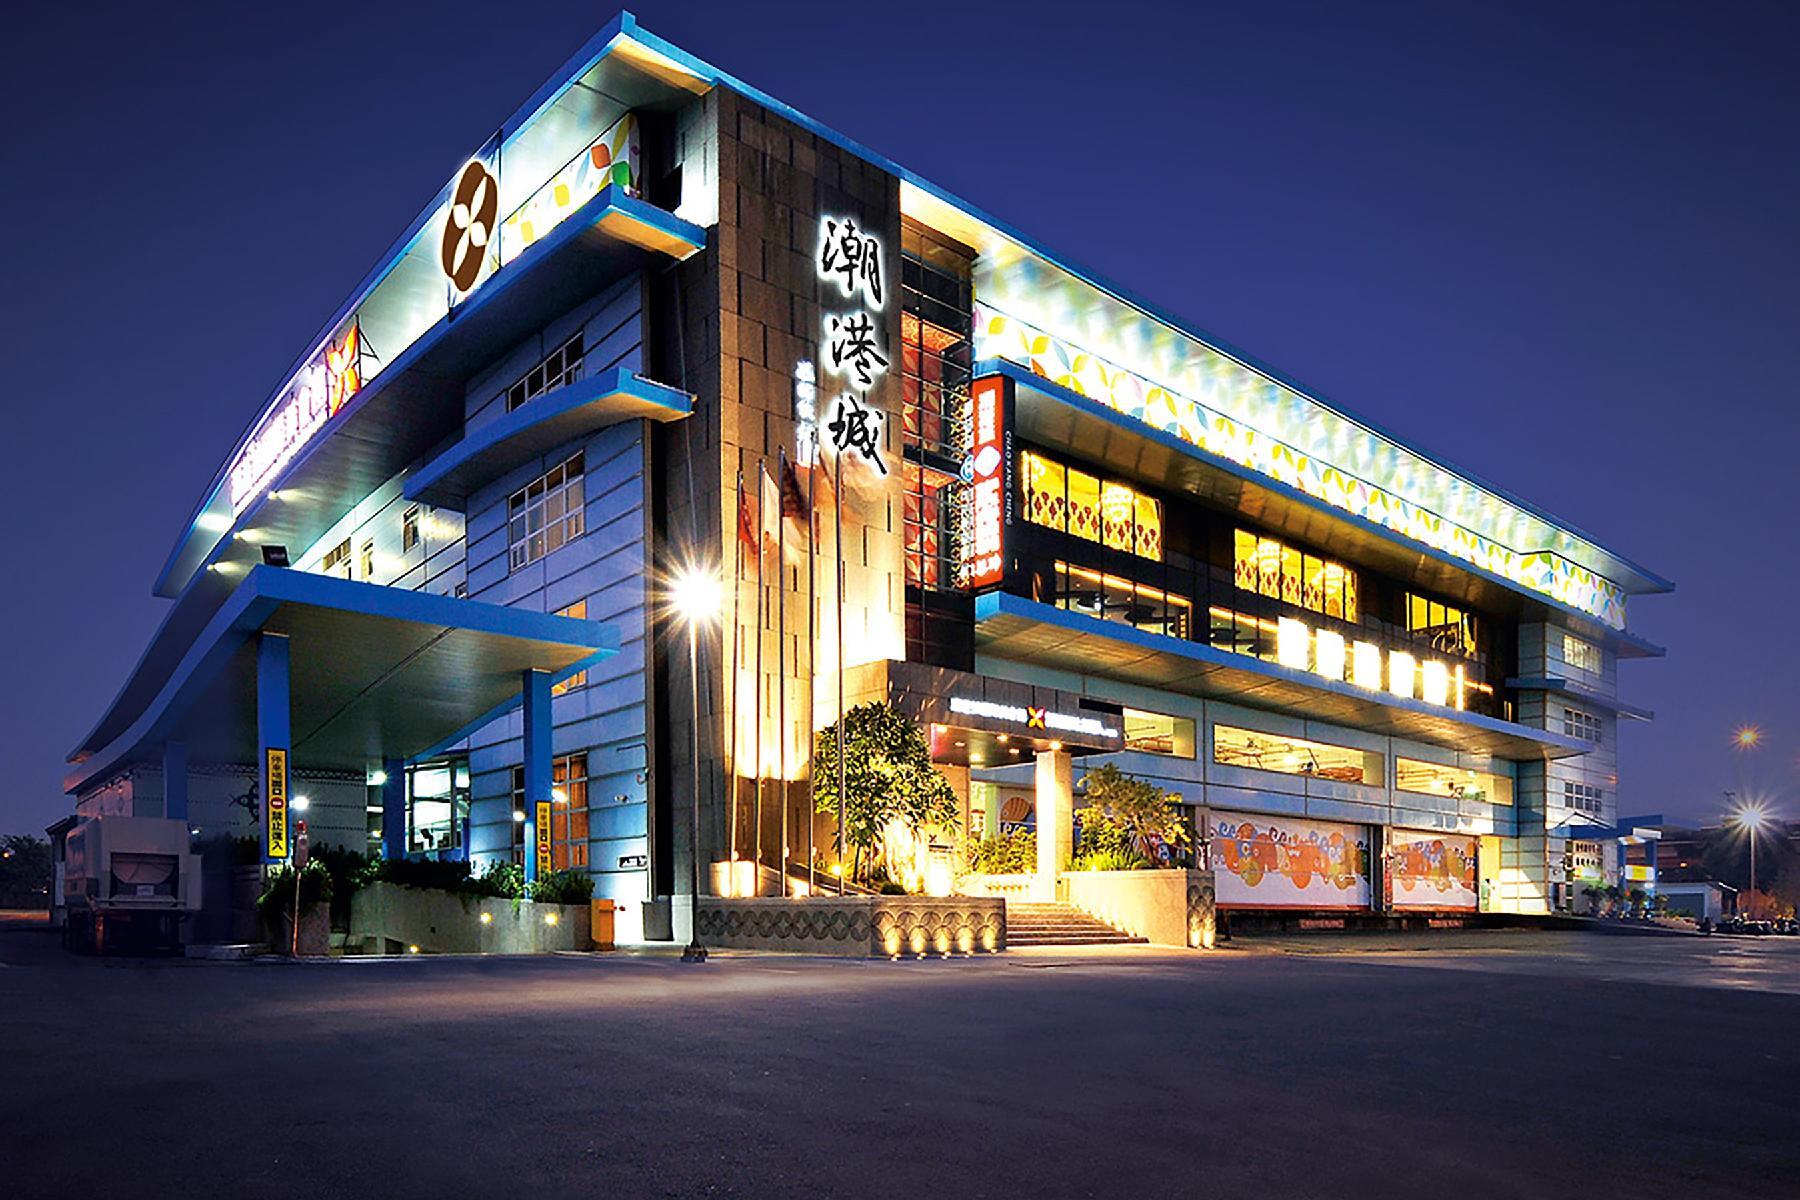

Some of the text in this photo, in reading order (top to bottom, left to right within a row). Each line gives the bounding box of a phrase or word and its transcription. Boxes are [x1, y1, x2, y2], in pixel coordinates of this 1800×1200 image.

[821, 219, 889, 475] 潮港城
[1004, 430, 1013, 526] CHAO KANG CHENG
